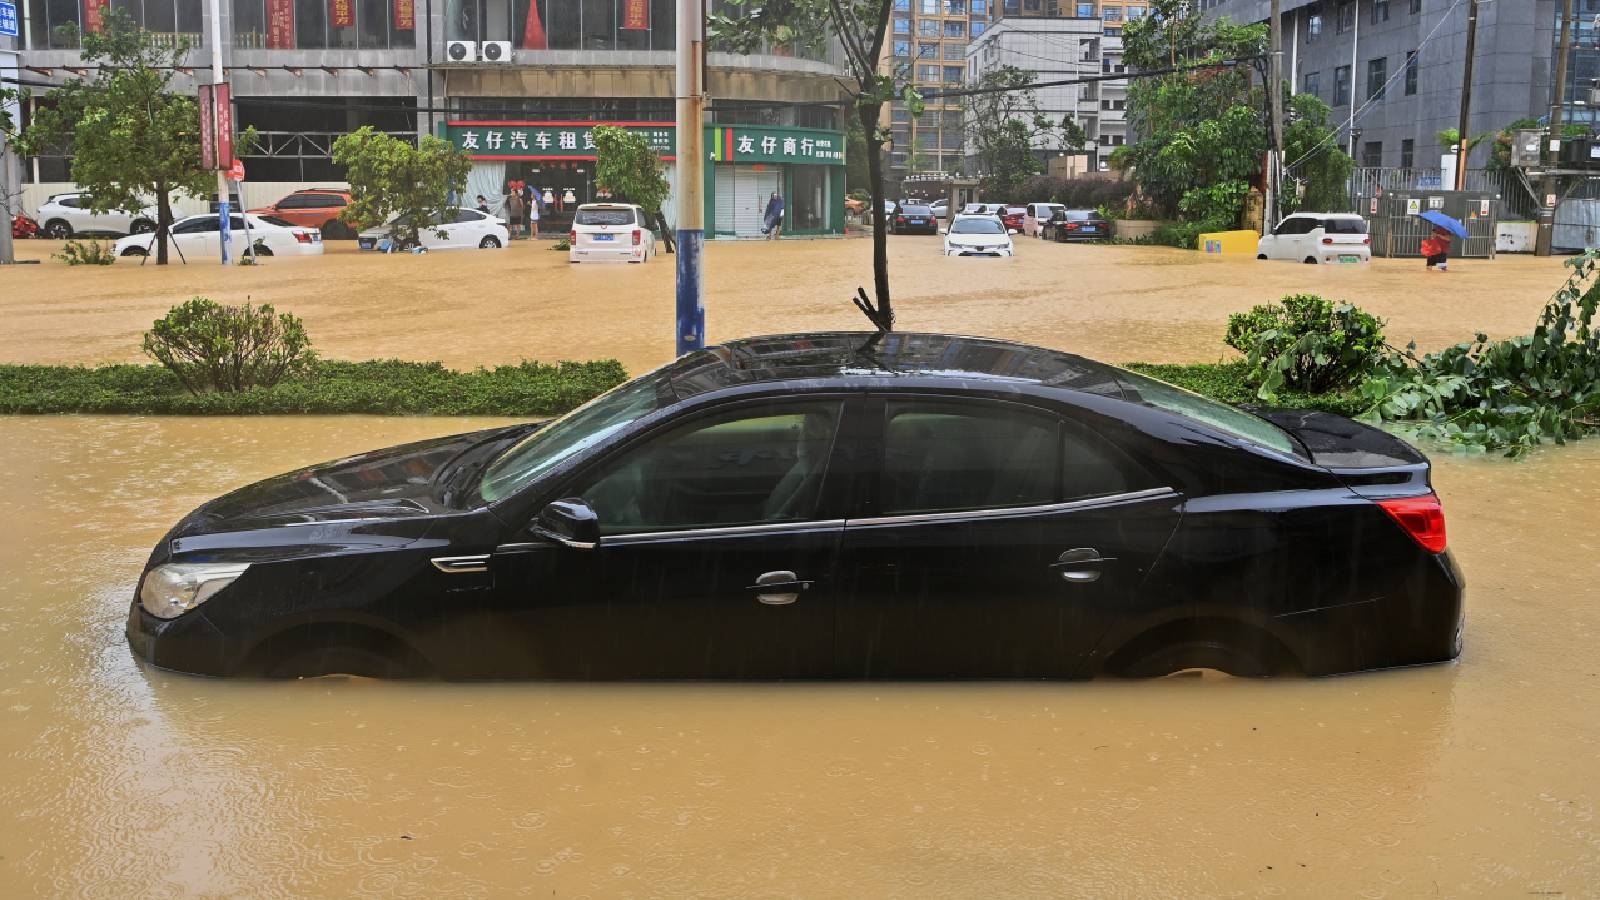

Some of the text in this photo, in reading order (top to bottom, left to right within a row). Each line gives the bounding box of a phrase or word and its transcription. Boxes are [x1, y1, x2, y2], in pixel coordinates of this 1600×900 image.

[462, 131, 598, 150] 友仔汽车租赁
[737, 135, 814, 156] 友仔商行
